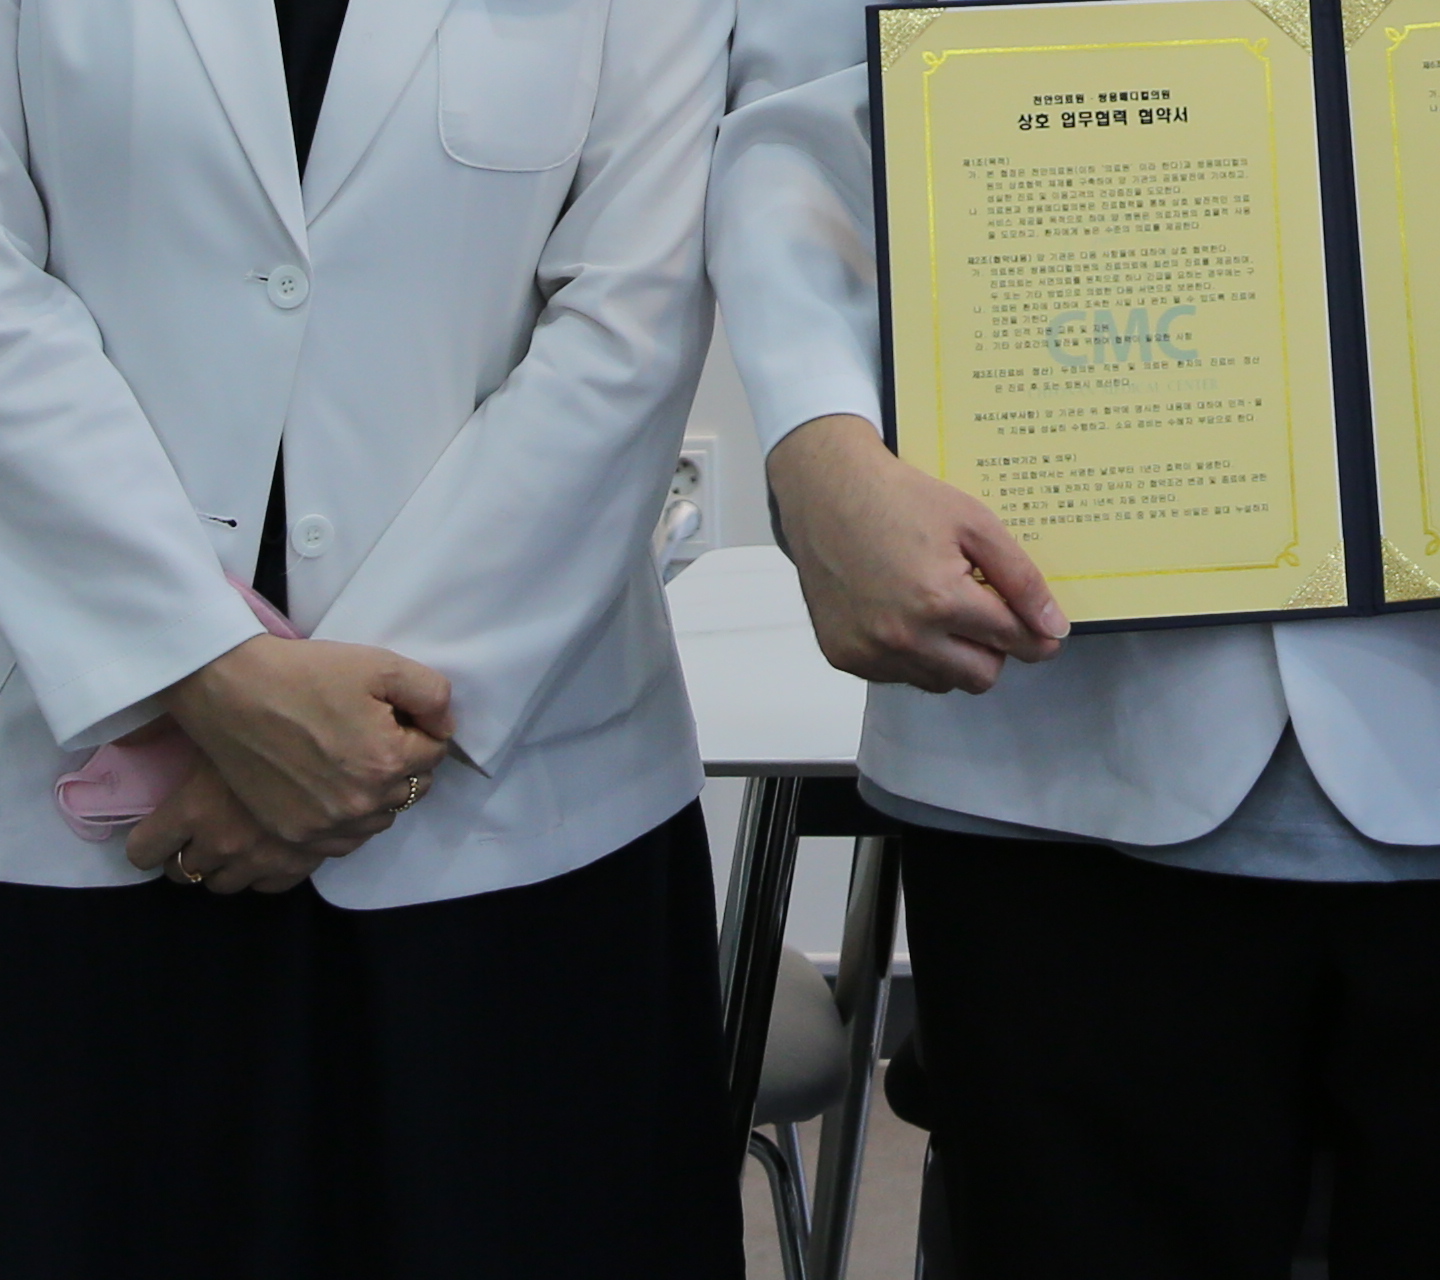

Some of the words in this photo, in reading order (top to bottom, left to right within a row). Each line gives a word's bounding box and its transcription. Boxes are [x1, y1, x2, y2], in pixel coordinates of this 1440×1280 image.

[1015, 111, 1052, 132] 상호
[1060, 106, 1128, 130] 업무협력
[1137, 103, 1189, 127] 협약서
[1048, 304, 1198, 366] CMC
